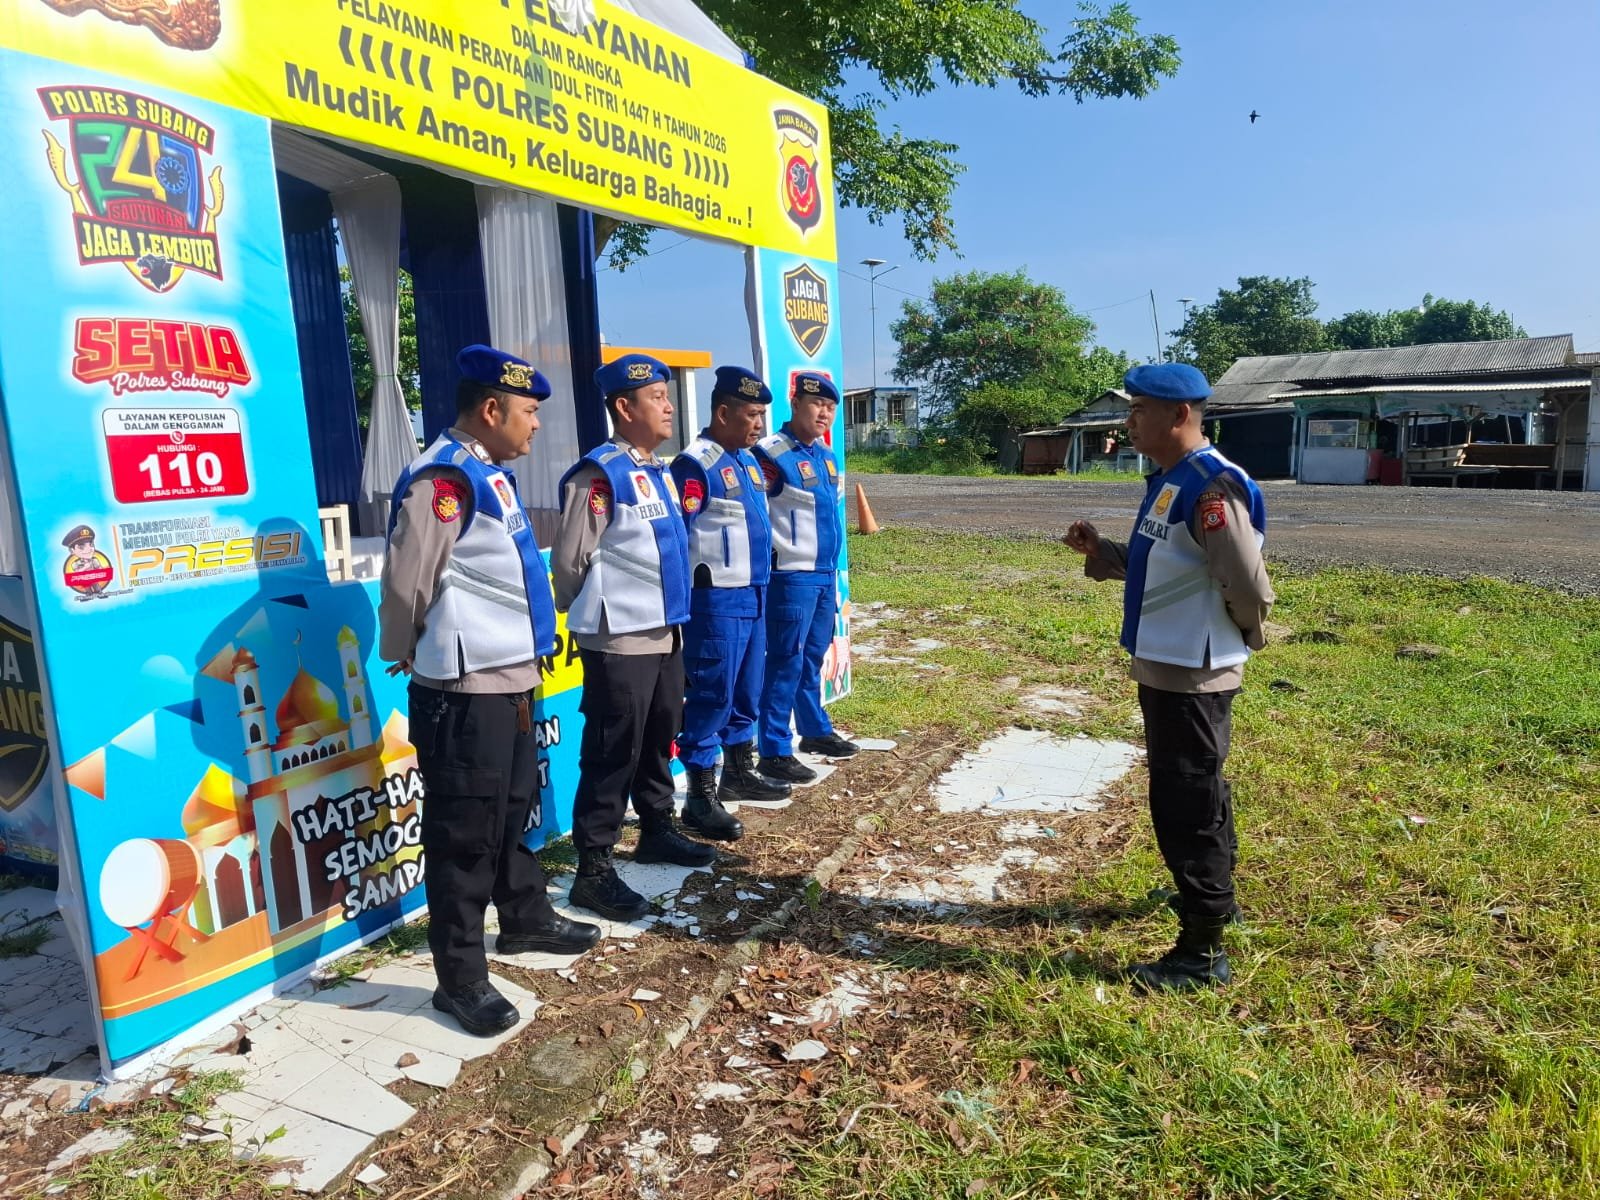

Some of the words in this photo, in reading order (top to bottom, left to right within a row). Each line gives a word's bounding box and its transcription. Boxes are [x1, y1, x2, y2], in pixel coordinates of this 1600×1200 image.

[500, 0, 692, 88] ELYANAN
[511, 24, 562, 64] DALAM
[567, 48, 623, 89] RANGKA
[459, 33, 544, 86] PERAYAAN
[548, 67, 582, 99] IDUL
[585, 83, 618, 113] FITRI
[622, 98, 649, 125] 1447
[653, 110, 661, 129] H
[664, 114, 701, 145] TAHUN
[704, 130, 727, 154] 2026
[50, 90, 129, 116] POLRES
[136, 99, 209, 147] SUBANG
[452, 66, 569, 134] POLRES
[577, 112, 673, 169] SUBANG
[778, 113, 796, 128] JAWA
[795, 118, 816, 138] BARAT
[285, 61, 406, 131] Mudik
[417, 106, 516, 168] Aman,
[526, 138, 636, 199] Keluarga
[644, 174, 722, 221] Bahagia
[82, 221, 135, 258] JAGA
[136, 231, 218, 272] LEMBUR
[792, 279, 820, 299] JAGA
[786, 299, 828, 324] SUBANG
[74, 319, 250, 383] SETIA
[112, 372, 167, 391] Polres
[171, 371, 228, 395] Subang
[119, 413, 166, 421] LAYANAN
[169, 412, 226, 421] KEPOLISIAN
[124, 422, 159, 430] DALAM
[157, 444, 196, 453] HUBUNGI
[139, 451, 223, 489] 110
[120, 516, 211, 536] TRANSFORMASI
[639, 502, 665, 519] HERI
[1140, 518, 1169, 540] POLRI
[122, 532, 172, 550] MENUJU
[211, 526, 241, 540] YANG
[129, 532, 301, 578] PRESISI
[297, 770, 426, 842] HATI-HA
[325, 816, 422, 881] SEMOG
